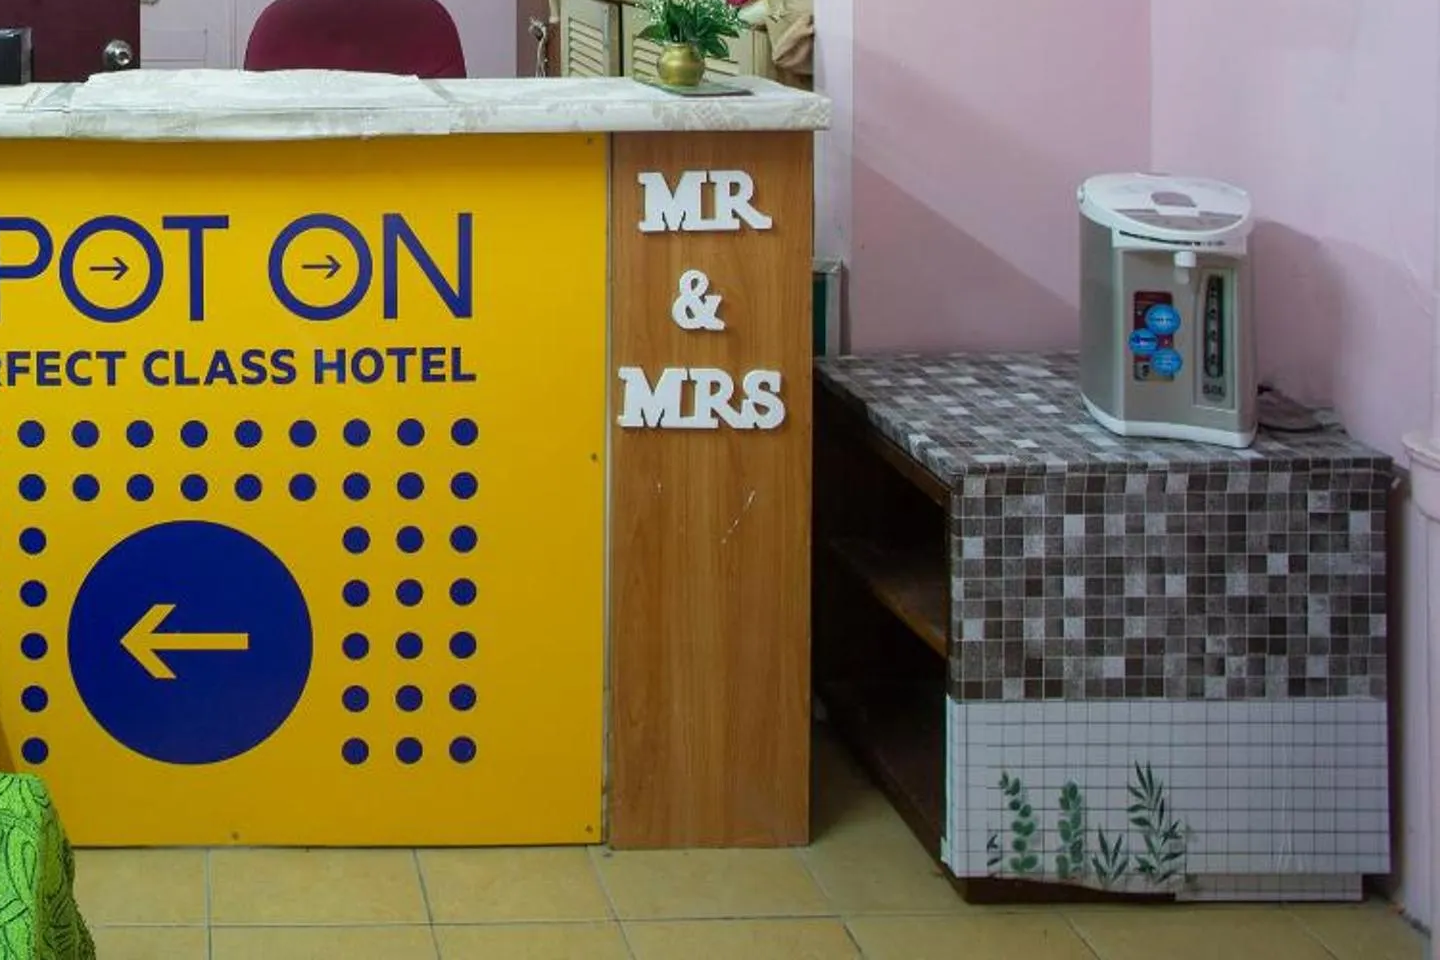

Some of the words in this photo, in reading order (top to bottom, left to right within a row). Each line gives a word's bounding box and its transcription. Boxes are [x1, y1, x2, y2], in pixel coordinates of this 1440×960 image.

[638, 170, 773, 232] MR
[267, 212, 473, 321] ON
[671, 269, 726, 331] &
[142, 348, 298, 387] CLASS
[313, 346, 477, 385] HOTEL
[617, 366, 787, 430] MRS
